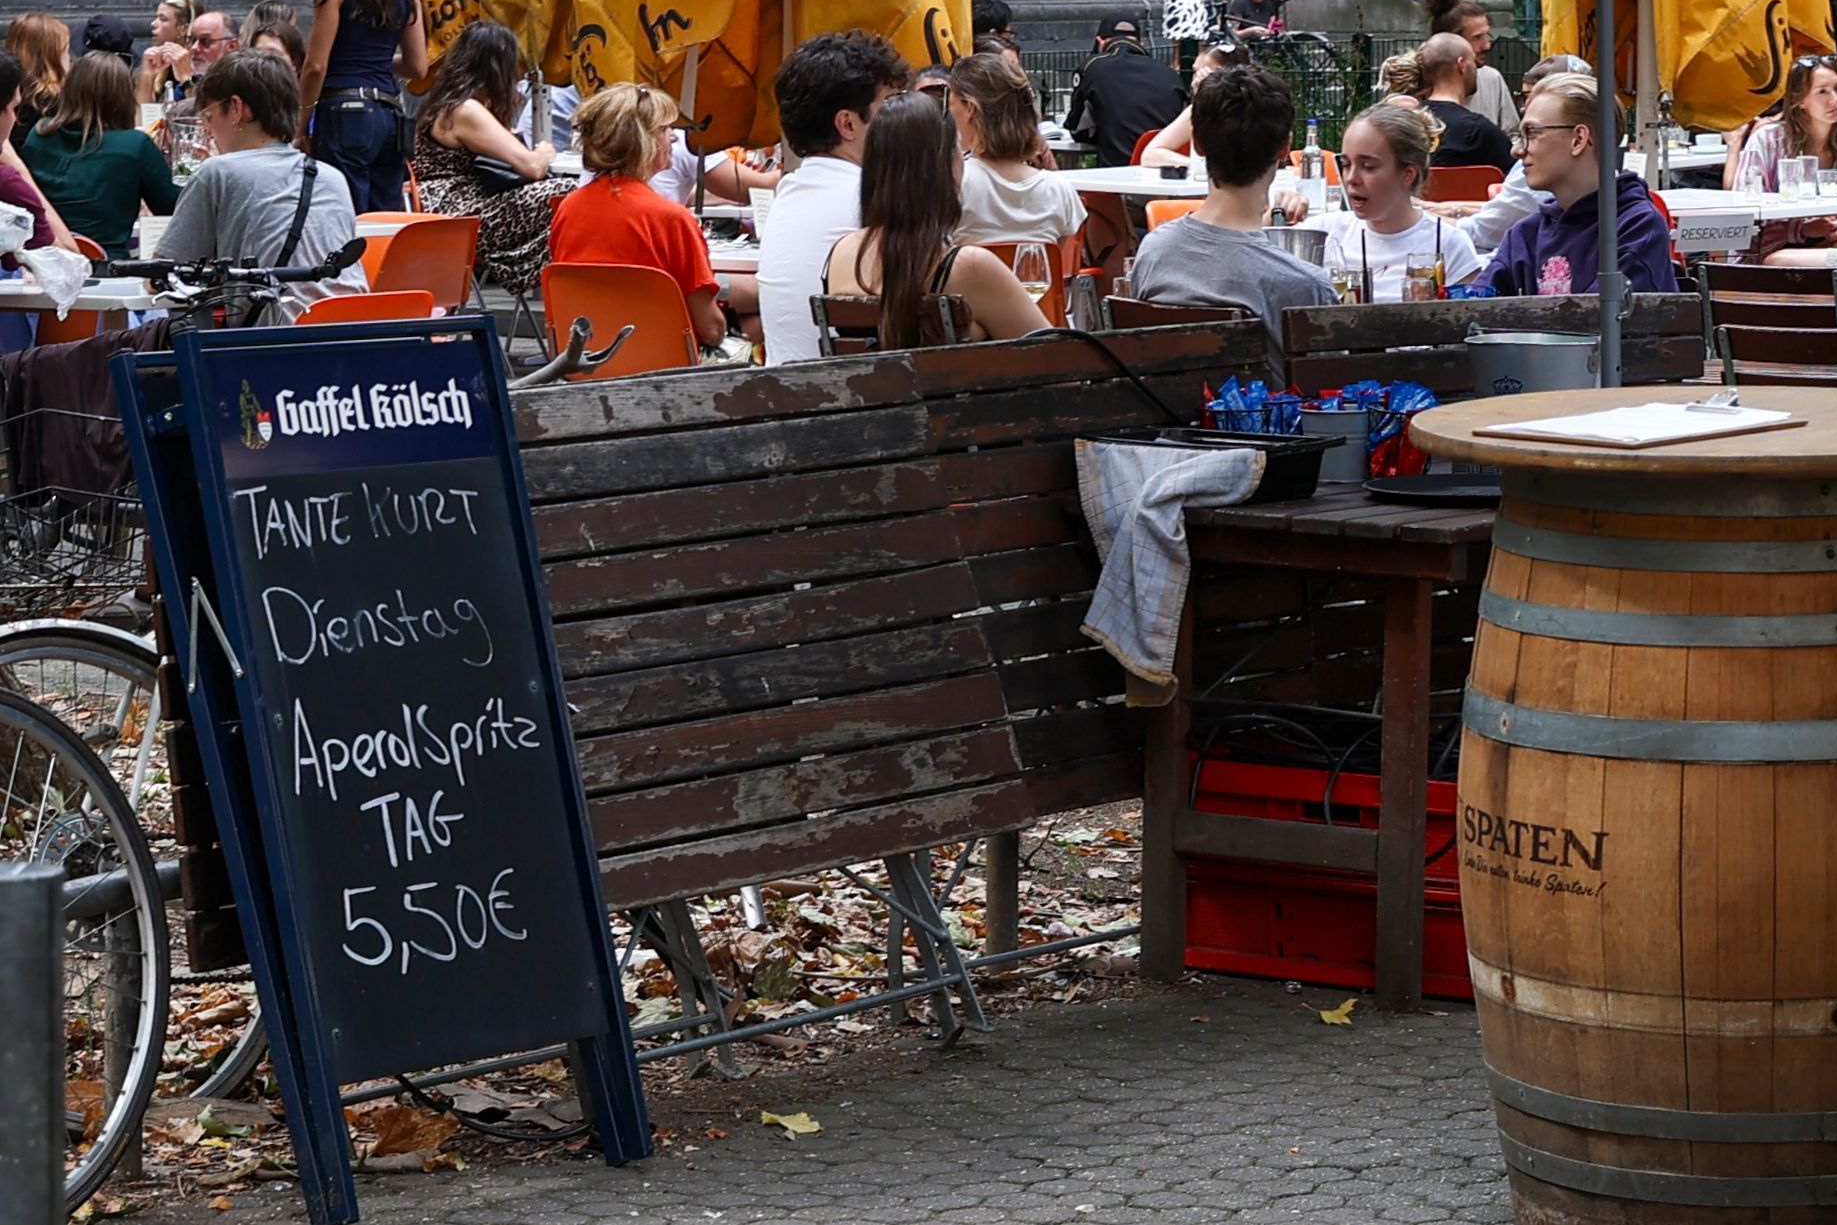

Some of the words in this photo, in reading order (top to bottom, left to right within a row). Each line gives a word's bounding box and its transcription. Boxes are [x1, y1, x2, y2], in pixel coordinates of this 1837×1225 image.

[1680, 225, 1750, 241] RESERVIERT
[276, 383, 370, 438] Gaffel
[369, 377, 473, 430] Kölsch
[232, 485, 352, 560] TANTE
[362, 481, 479, 537] KURT
[261, 586, 494, 667] Dienstag
[360, 789, 465, 868] TAG
[1464, 804, 1610, 871] SPATEN
[341, 868, 527, 975] 5,50€
[1544, 873, 1608, 898] Spaten!
